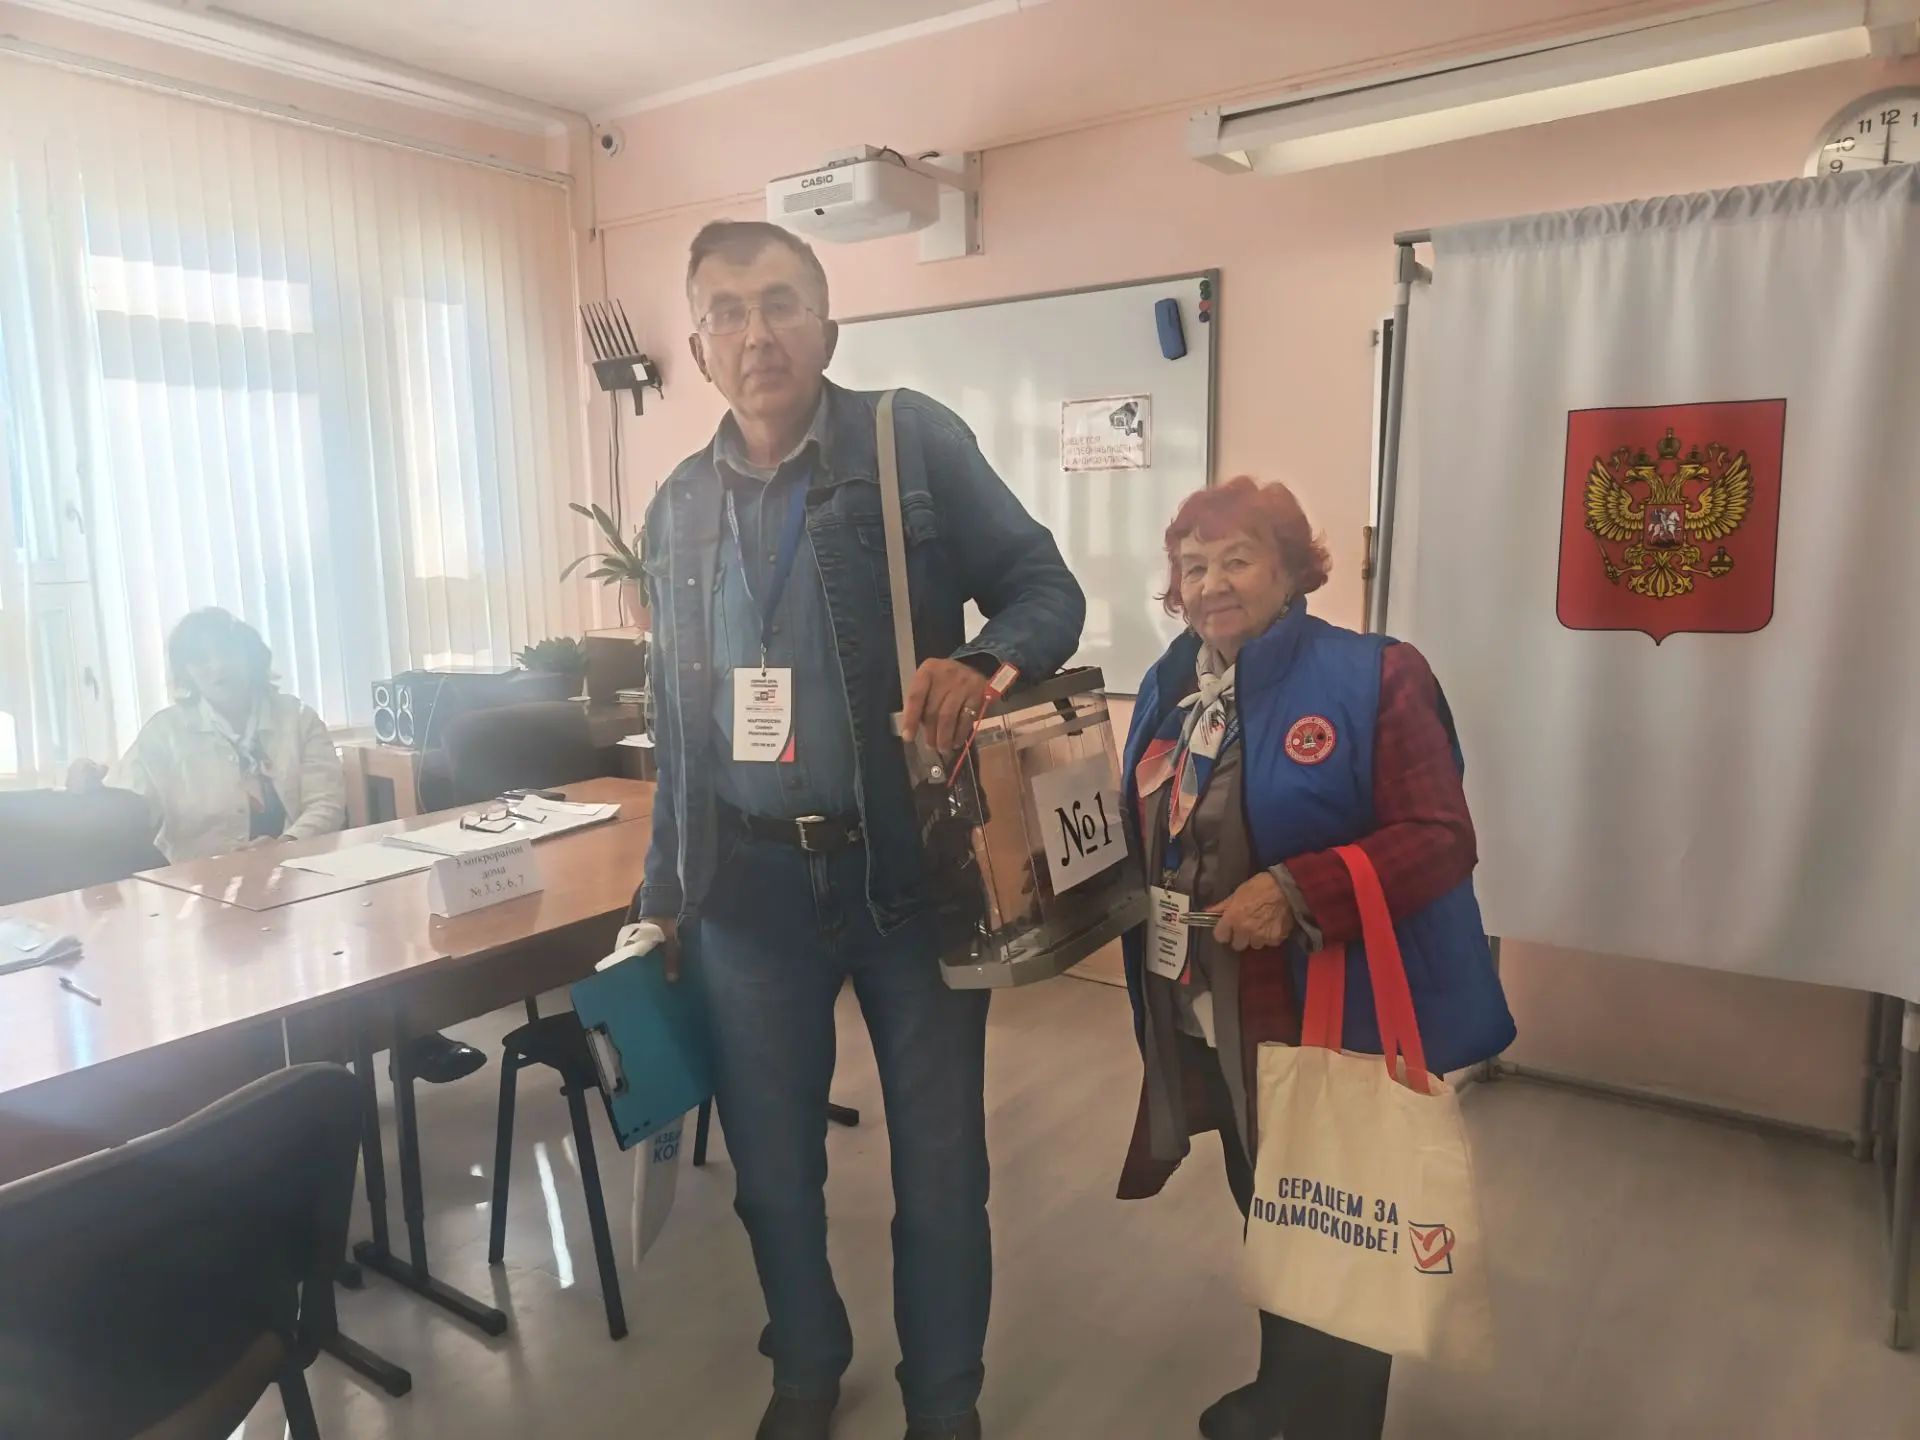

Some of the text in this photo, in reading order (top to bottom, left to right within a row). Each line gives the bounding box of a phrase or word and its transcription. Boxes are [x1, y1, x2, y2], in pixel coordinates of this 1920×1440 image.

[1880, 109, 1901, 125] 12
[1857, 119, 1872, 134] 11
[1829, 159, 1843, 174] 9
[801, 174, 834, 188] CASIO
[482, 866, 506, 879] дома
[469, 887, 482, 898] №
[518, 875, 525, 885] 7
[1278, 1177, 1399, 1226] СЕРДЦЕМ ЗА
[1254, 1196, 1399, 1255] ПОДМОСКОВЬЕ!
